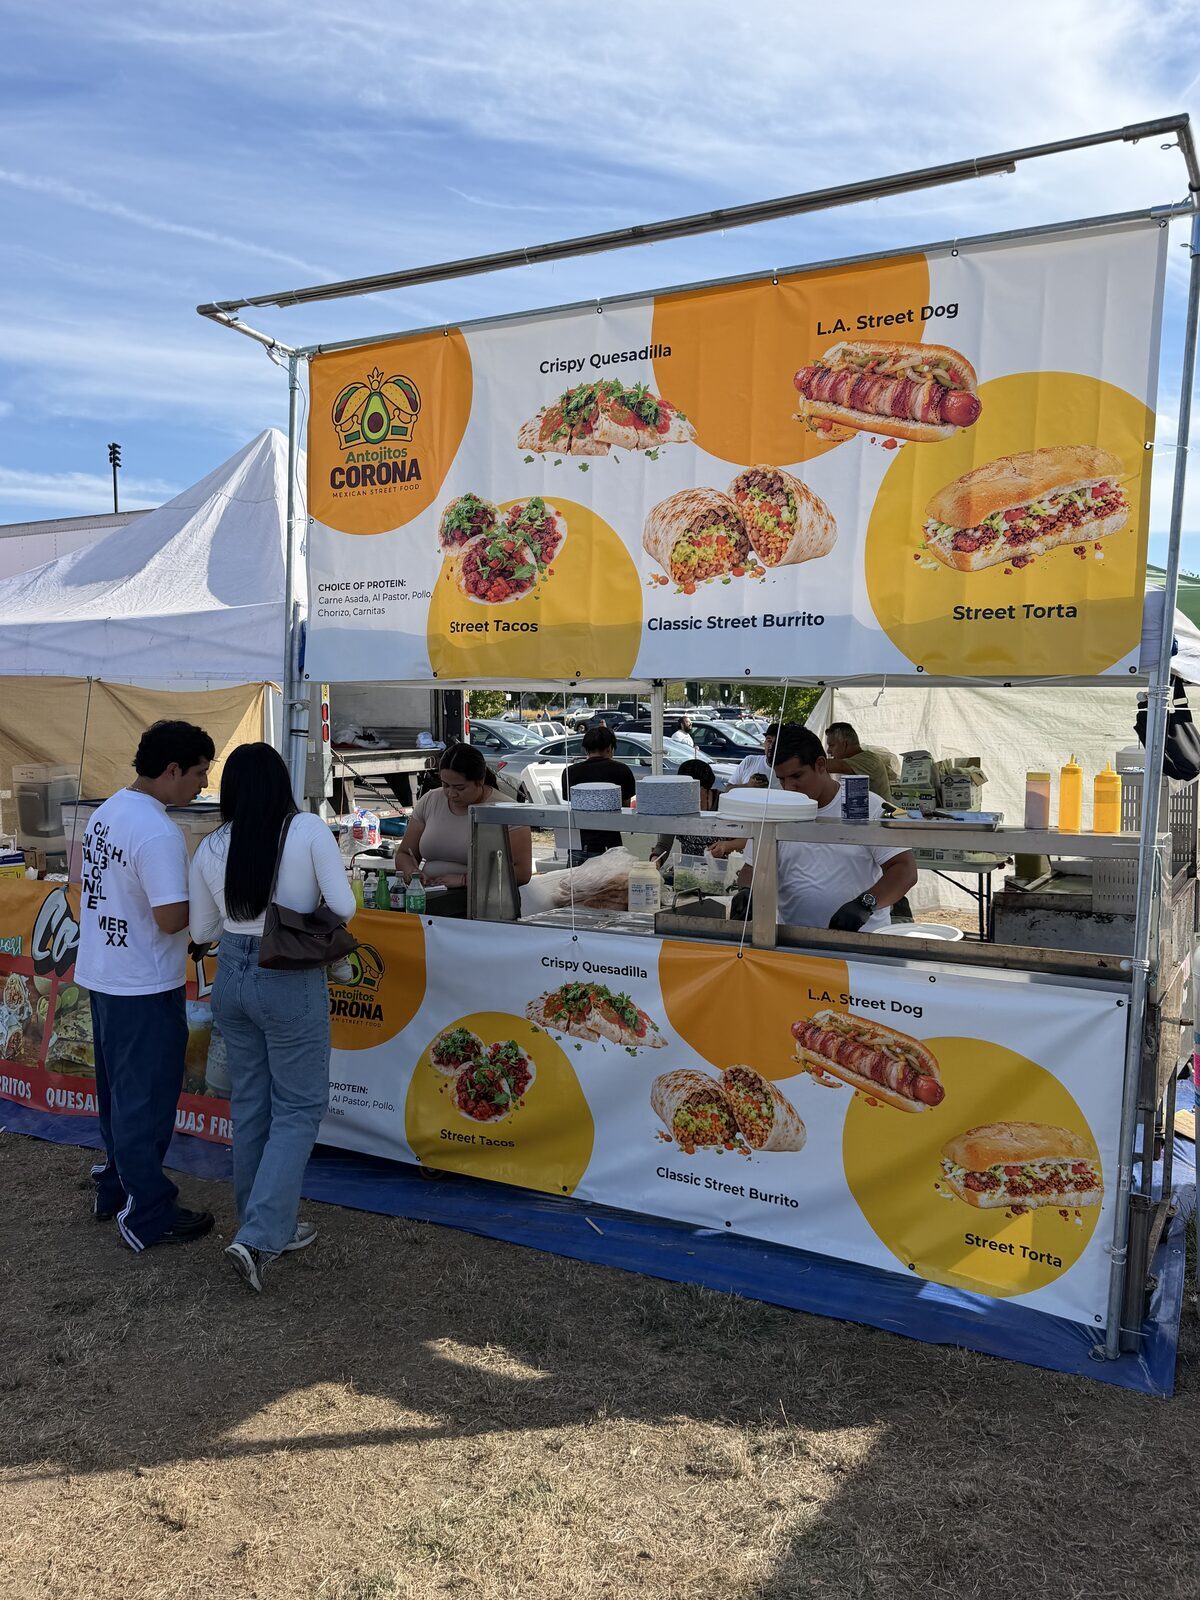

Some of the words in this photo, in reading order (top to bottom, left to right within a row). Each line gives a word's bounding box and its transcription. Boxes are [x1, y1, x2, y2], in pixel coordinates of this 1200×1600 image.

[817, 319, 851, 336] L.A.
[856, 309, 914, 330] Street
[920, 302, 959, 321] Dog
[539, 358, 586, 374] Crispy
[589, 344, 672, 369] Quesadilla
[345, 446, 408, 464] Antojitos
[330, 458, 422, 490] CORONA
[332, 489, 367, 498] MEXICAN
[370, 486, 397, 495] STREET
[400, 483, 420, 492] FOOD
[317, 582, 351, 592] CHOICE
[353, 581, 365, 590] OF
[367, 578, 407, 589] PROTEIN:
[318, 595, 343, 605] Carne
[344, 593, 371, 604] Asada,
[372, 592, 381, 602] Al
[382, 591, 410, 602] Pastor,
[412, 590, 433, 600] Pollo,
[317, 607, 351, 618] Chorizo,
[352, 606, 386, 616] Carnitas
[952, 605, 1016, 620] Street
[1022, 603, 1078, 619] Torta
[450, 620, 490, 633] Street
[493, 619, 538, 632] Tacos
[647, 616, 703, 631] Classic
[706, 615, 758, 629] Street
[763, 611, 825, 628] Burrito
[105, 931, 128, 947] XX
[541, 956, 580, 972] Crispy
[582, 961, 648, 979] Quesadilla
[328, 987, 374, 1002] Antojitos
[808, 989, 836, 1003] L.A.
[839, 993, 886, 1011] Street
[890, 1000, 923, 1019] Dog
[0, 1074, 31, 1100] RITOS
[328, 1081, 368, 1094] PROTEIN:
[332, 1094, 341, 1103] Al
[342, 1096, 371, 1109] Pastor,
[372, 1100, 395, 1112] Pollo,
[440, 1128, 476, 1145] Street
[478, 1135, 515, 1147] Tacos
[656, 1166, 701, 1186] Classic
[704, 1177, 745, 1197] Street
[749, 1187, 799, 1208] Burrito
[964, 1232, 1015, 1256] Street
[1019, 1245, 1062, 1268] Torta
